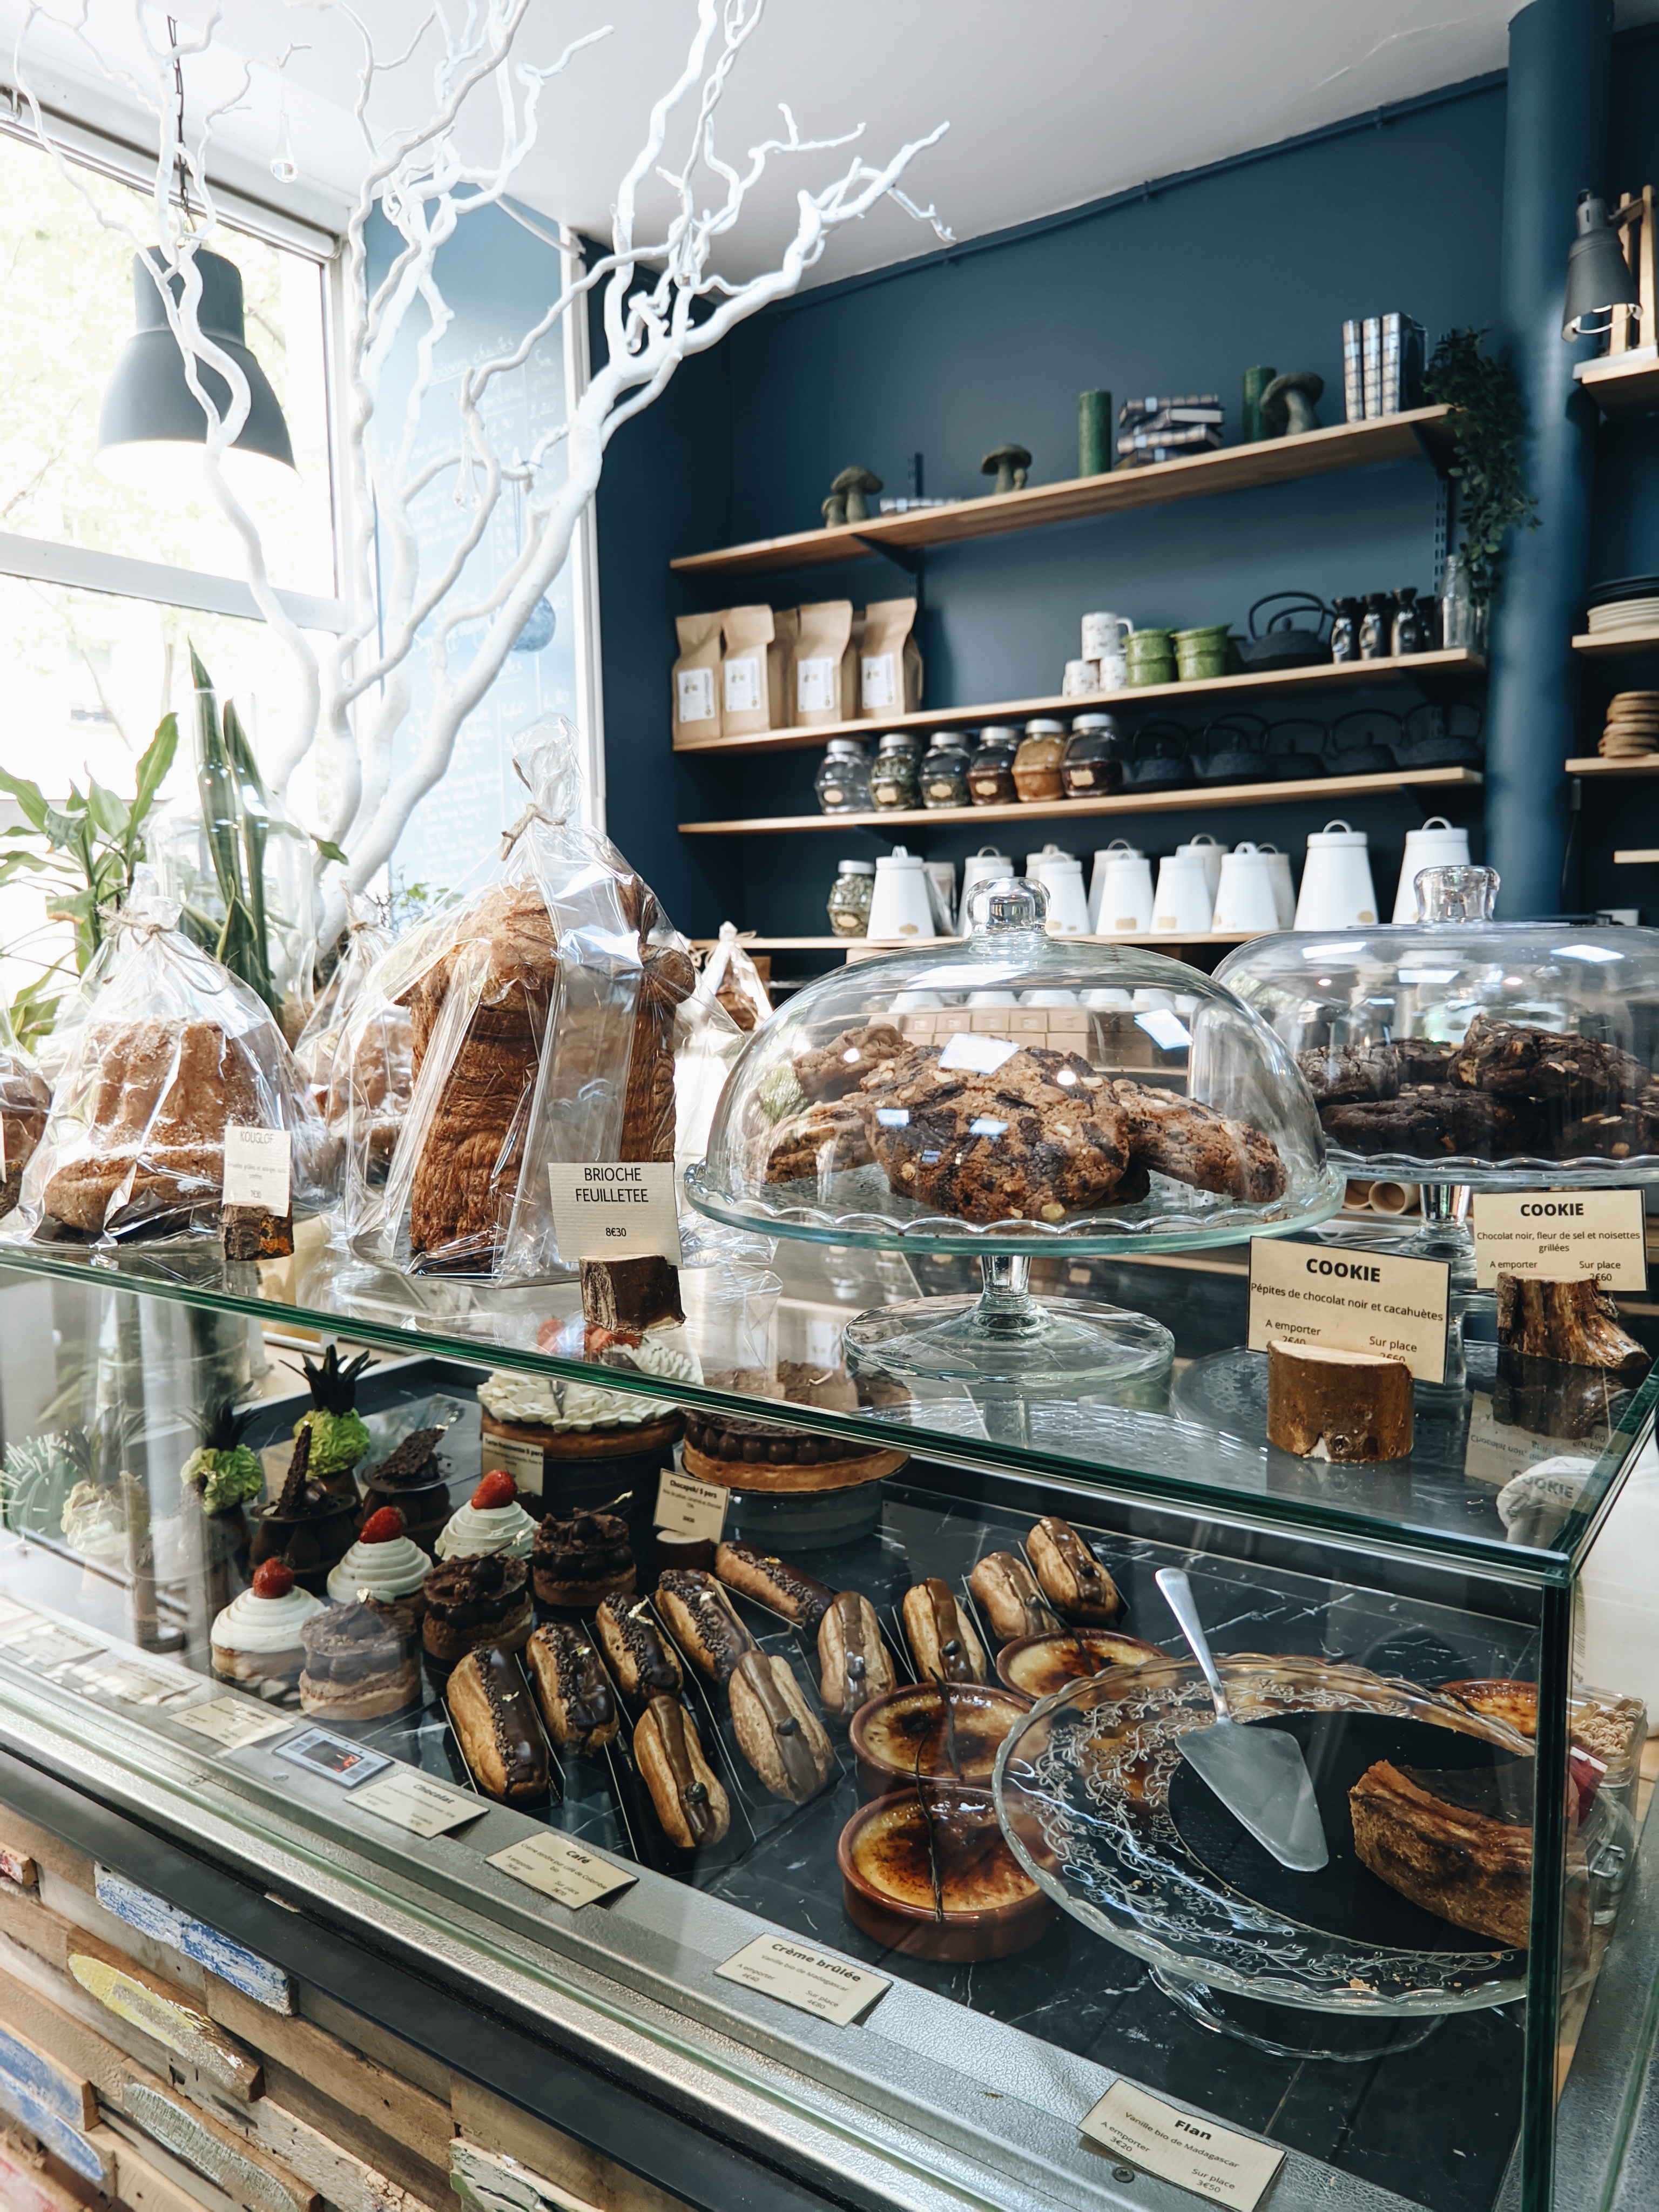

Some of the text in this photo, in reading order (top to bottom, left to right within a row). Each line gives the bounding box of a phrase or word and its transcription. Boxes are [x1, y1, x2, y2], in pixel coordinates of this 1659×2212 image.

[240, 1131, 274, 1144] KOUGLOF
[584, 1168, 642, 1181] BRIOCHE
[576, 1188, 649, 1202] FEUILLETEE
[1520, 1203, 1584, 1216] COOKIE
[605, 1228, 626, 1237] 8€30
[1476, 1232, 1513, 1240] Chocolat
[1515, 1232, 1535, 1241] noir,
[1536, 1231, 1556, 1240] fleur
[1559, 1231, 1570, 1239] de
[1573, 1231, 1584, 1239] sel
[1599, 1231, 1640, 1240] noisettes
[1539, 1244, 1570, 1253] grillées
[1306, 1258, 1380, 1283] COOKIE
[1498, 1262, 1537, 1271] emporter
[1597, 1261, 1621, 1270] place
[1251, 1283, 1443, 1321] Pépites de chocolat noir et cacahuètes
[1265, 1319, 1321, 1337] A emporter
[1369, 1336, 1418, 1353] Sur place
[413, 1784, 455, 1804] Chocolat
[566, 1850, 591, 1865] Café
[771, 1943, 861, 1982] Crème brûlée
[743, 1966, 776, 1981] emporter
[761, 1954, 849, 1992] Vanille bio de Madagascar
[805, 1990, 839, 2008] Sur place
[806, 1999, 826, 2009] 4€80
[1174, 2120, 1212, 2141] Flan
[1109, 2126, 1151, 2153] emporter
[1109, 2136, 1133, 2153] 3€20
[1125, 2112, 1240, 2168] Vanille bio de Madagascar
[1191, 2168, 1236, 2190] Sur place
[1196, 2180, 1221, 2194] 3€50
